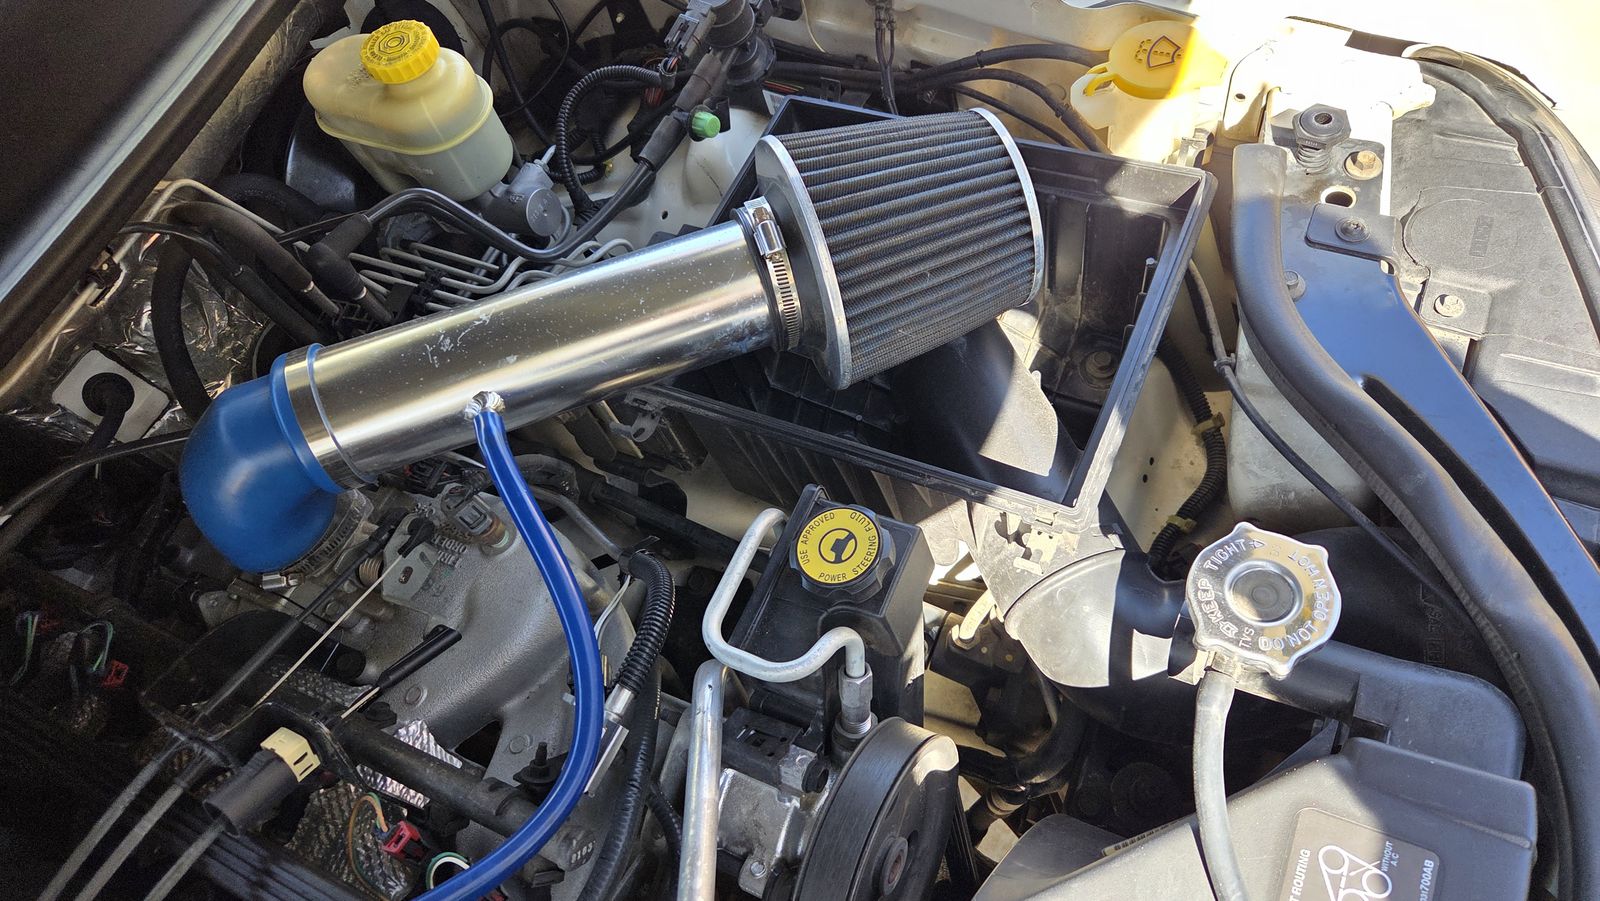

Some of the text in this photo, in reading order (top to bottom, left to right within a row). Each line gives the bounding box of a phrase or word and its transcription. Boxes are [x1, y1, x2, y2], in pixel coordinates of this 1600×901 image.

[800, 512, 835, 565] USE APPROVED
[818, 512, 877, 582] POWER STEERING FLUID
[1198, 538, 1248, 623] KEEP TIGHT
[1258, 550, 1330, 651] DO NOT OPEN HOT
[1291, 849, 1311, 896] ROUTING
[1381, 841, 1393, 871] WITHOUT
